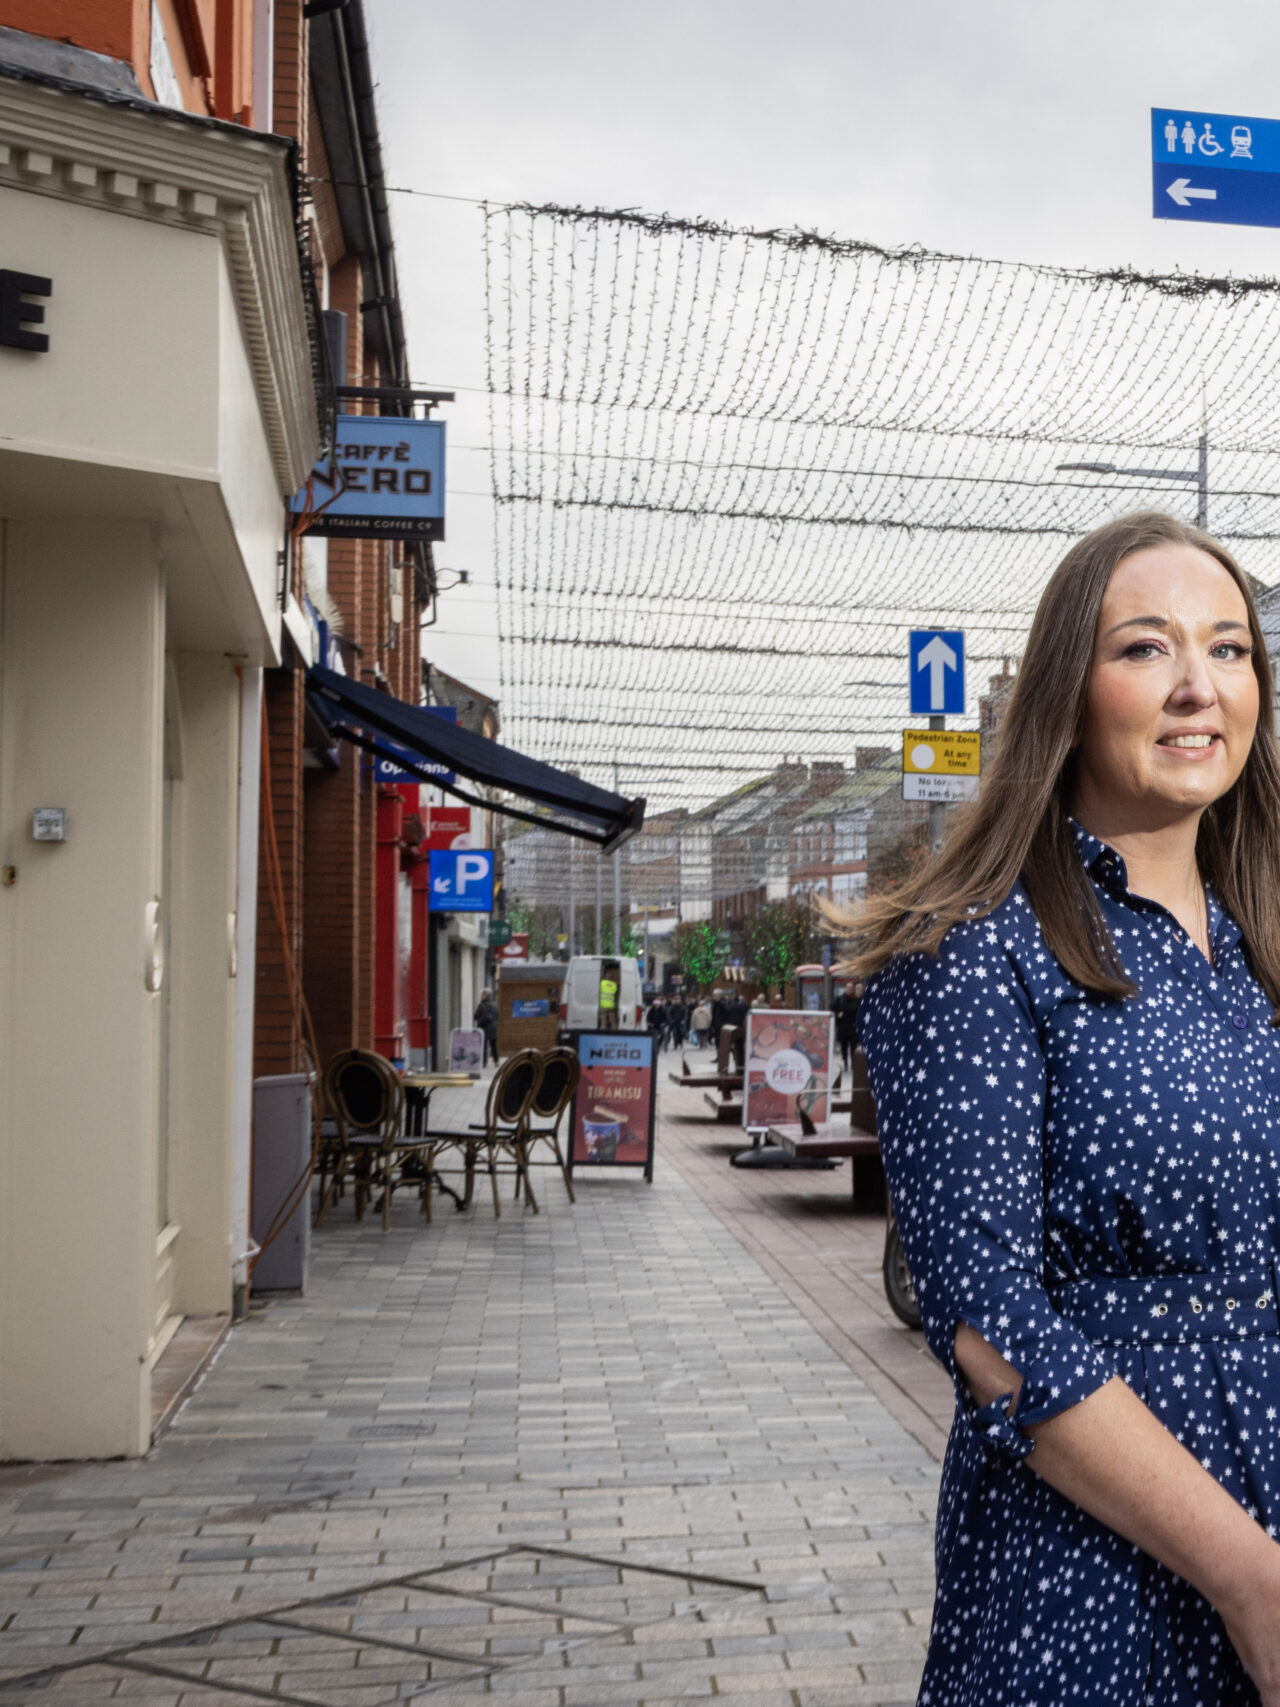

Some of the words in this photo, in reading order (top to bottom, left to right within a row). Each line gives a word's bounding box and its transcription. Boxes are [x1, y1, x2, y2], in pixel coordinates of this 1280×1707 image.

[0, 270, 52, 353] E
[311, 466, 432, 496] NERO
[329, 519, 371, 528] ITALIAN
[374, 519, 413, 530] COFFEE
[907, 732, 954, 743] Pedestrian
[957, 735, 978, 744] Zone
[944, 750, 954, 758] At
[957, 752, 972, 760] any
[948, 759, 967, 768] time
[918, 777, 931, 785] No
[456, 854, 489, 895] P
[589, 1048, 642, 1060] NERO
[772, 1069, 804, 1081] FREE
[586, 1085, 642, 1100] TIRAMISU
